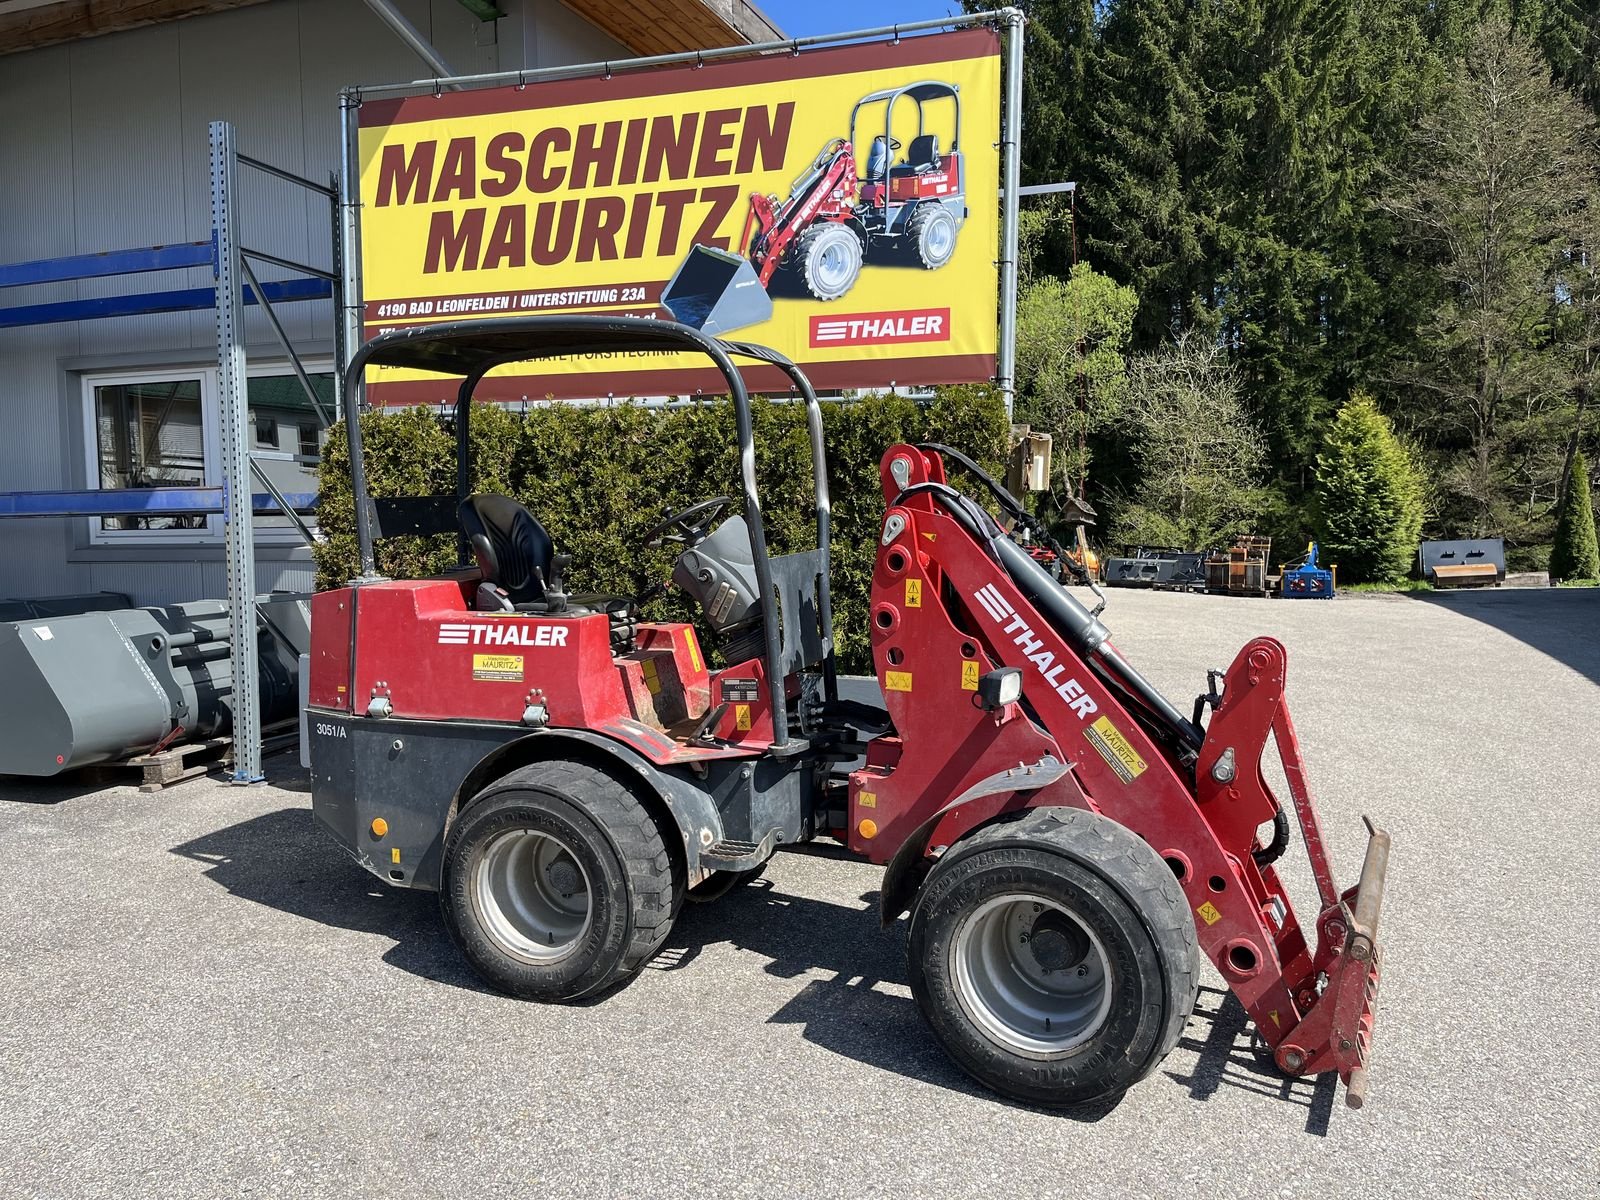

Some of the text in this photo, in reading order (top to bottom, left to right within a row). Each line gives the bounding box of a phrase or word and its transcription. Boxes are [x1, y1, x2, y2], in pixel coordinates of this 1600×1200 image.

[375, 101, 796, 208] MASCHINEN
[423, 185, 740, 274] MAURITZ
[378, 303, 406, 317] 4190
[409, 302, 433, 315] BAD
[436, 296, 510, 313] LEONFELDEN
[520, 289, 618, 308] UNTERSTIFTUNG
[621, 287, 646, 302] 23A
[842, 315, 943, 339] THALER
[470, 624, 569, 647] THALER
[482, 660, 514, 670] MAURITZ
[1003, 612, 1098, 720] THALER
[316, 722, 347, 739] 3051/A
[1101, 728, 1136, 767] MAURITZ
